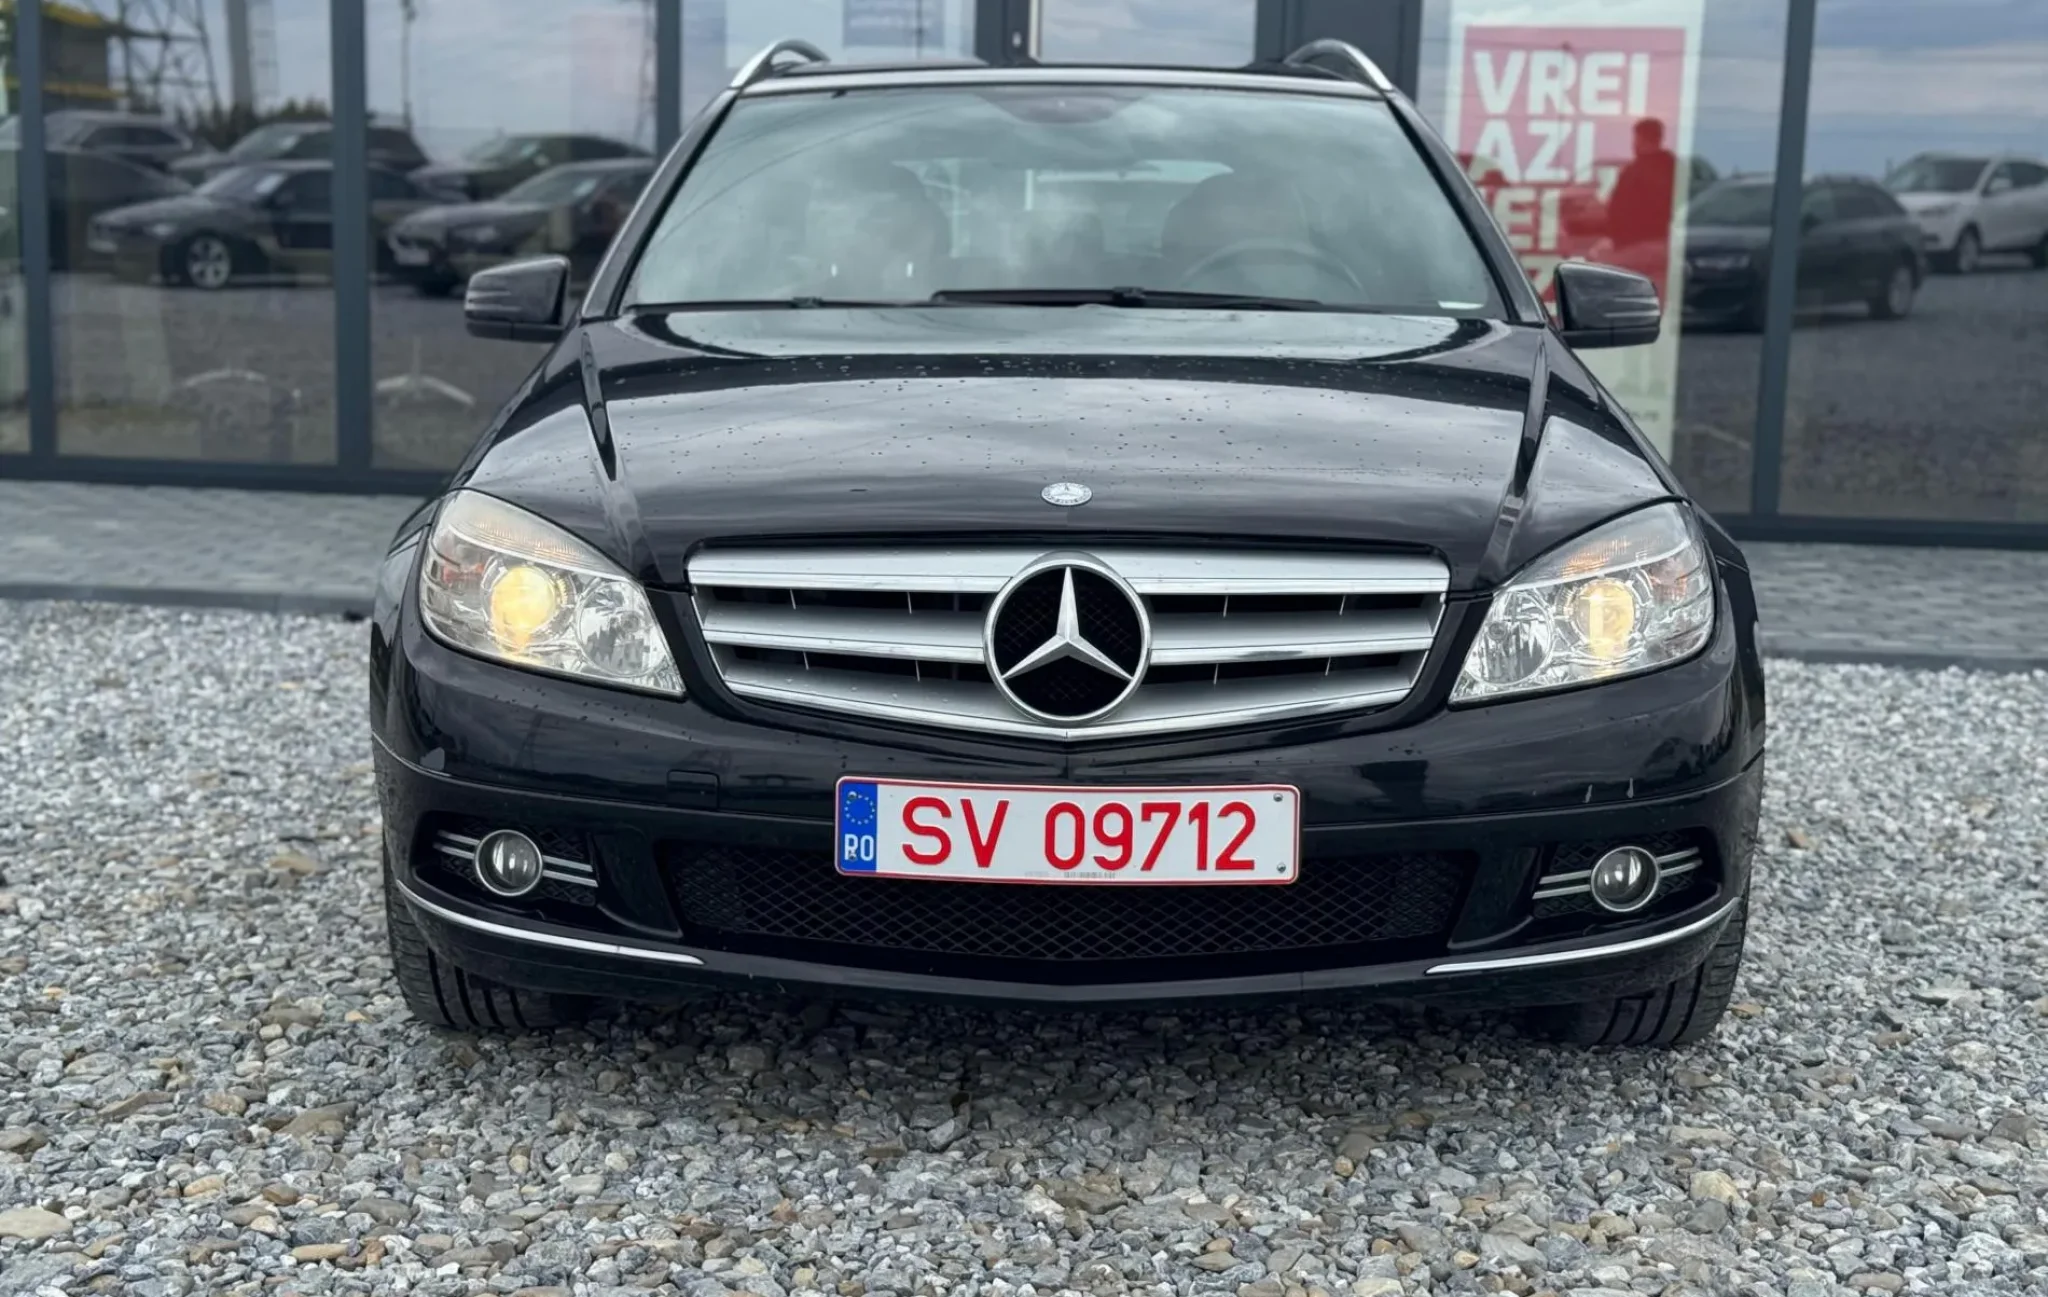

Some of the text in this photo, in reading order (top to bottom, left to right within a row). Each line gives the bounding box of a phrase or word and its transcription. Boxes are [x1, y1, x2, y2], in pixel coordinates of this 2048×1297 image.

[1473, 50, 1649, 116] VREI
[1478, 185, 1561, 250] EI
[844, 833, 875, 862] RO
[902, 796, 1256, 871] SV 09712
